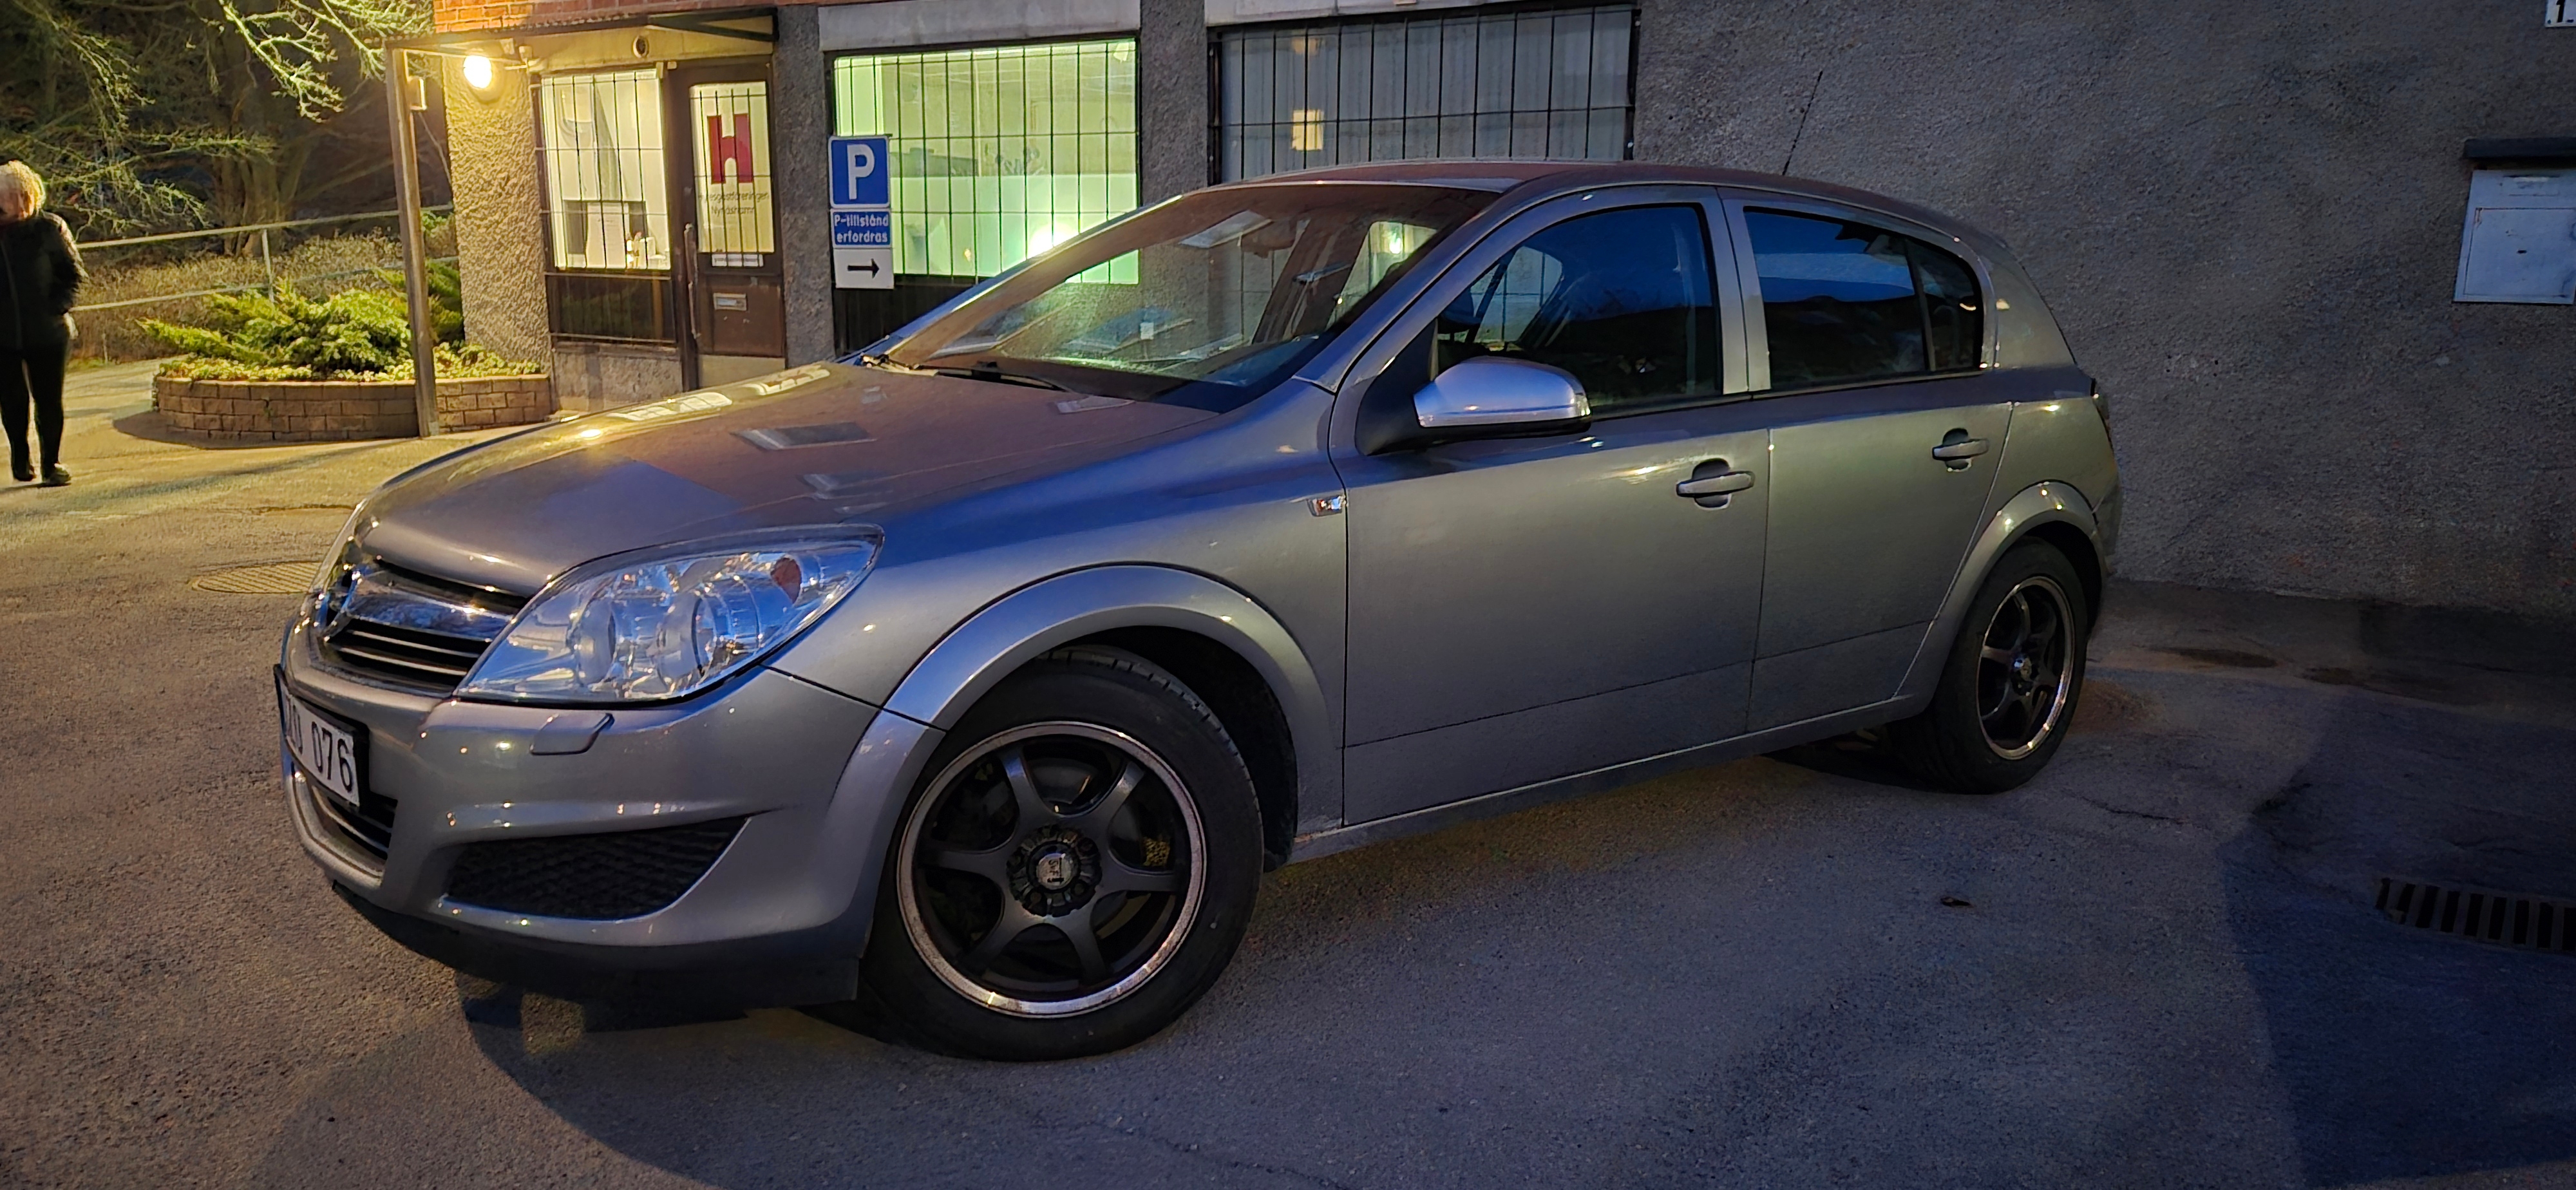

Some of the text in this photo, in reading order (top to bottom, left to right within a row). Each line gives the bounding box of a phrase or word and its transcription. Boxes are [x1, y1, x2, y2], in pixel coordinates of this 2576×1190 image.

[706, 113, 753, 185] H
[847, 144, 875, 200] P
[834, 214, 889, 227] P-tillstånd
[837, 230, 888, 243] erfordras
[311, 721, 354, 793] 076
